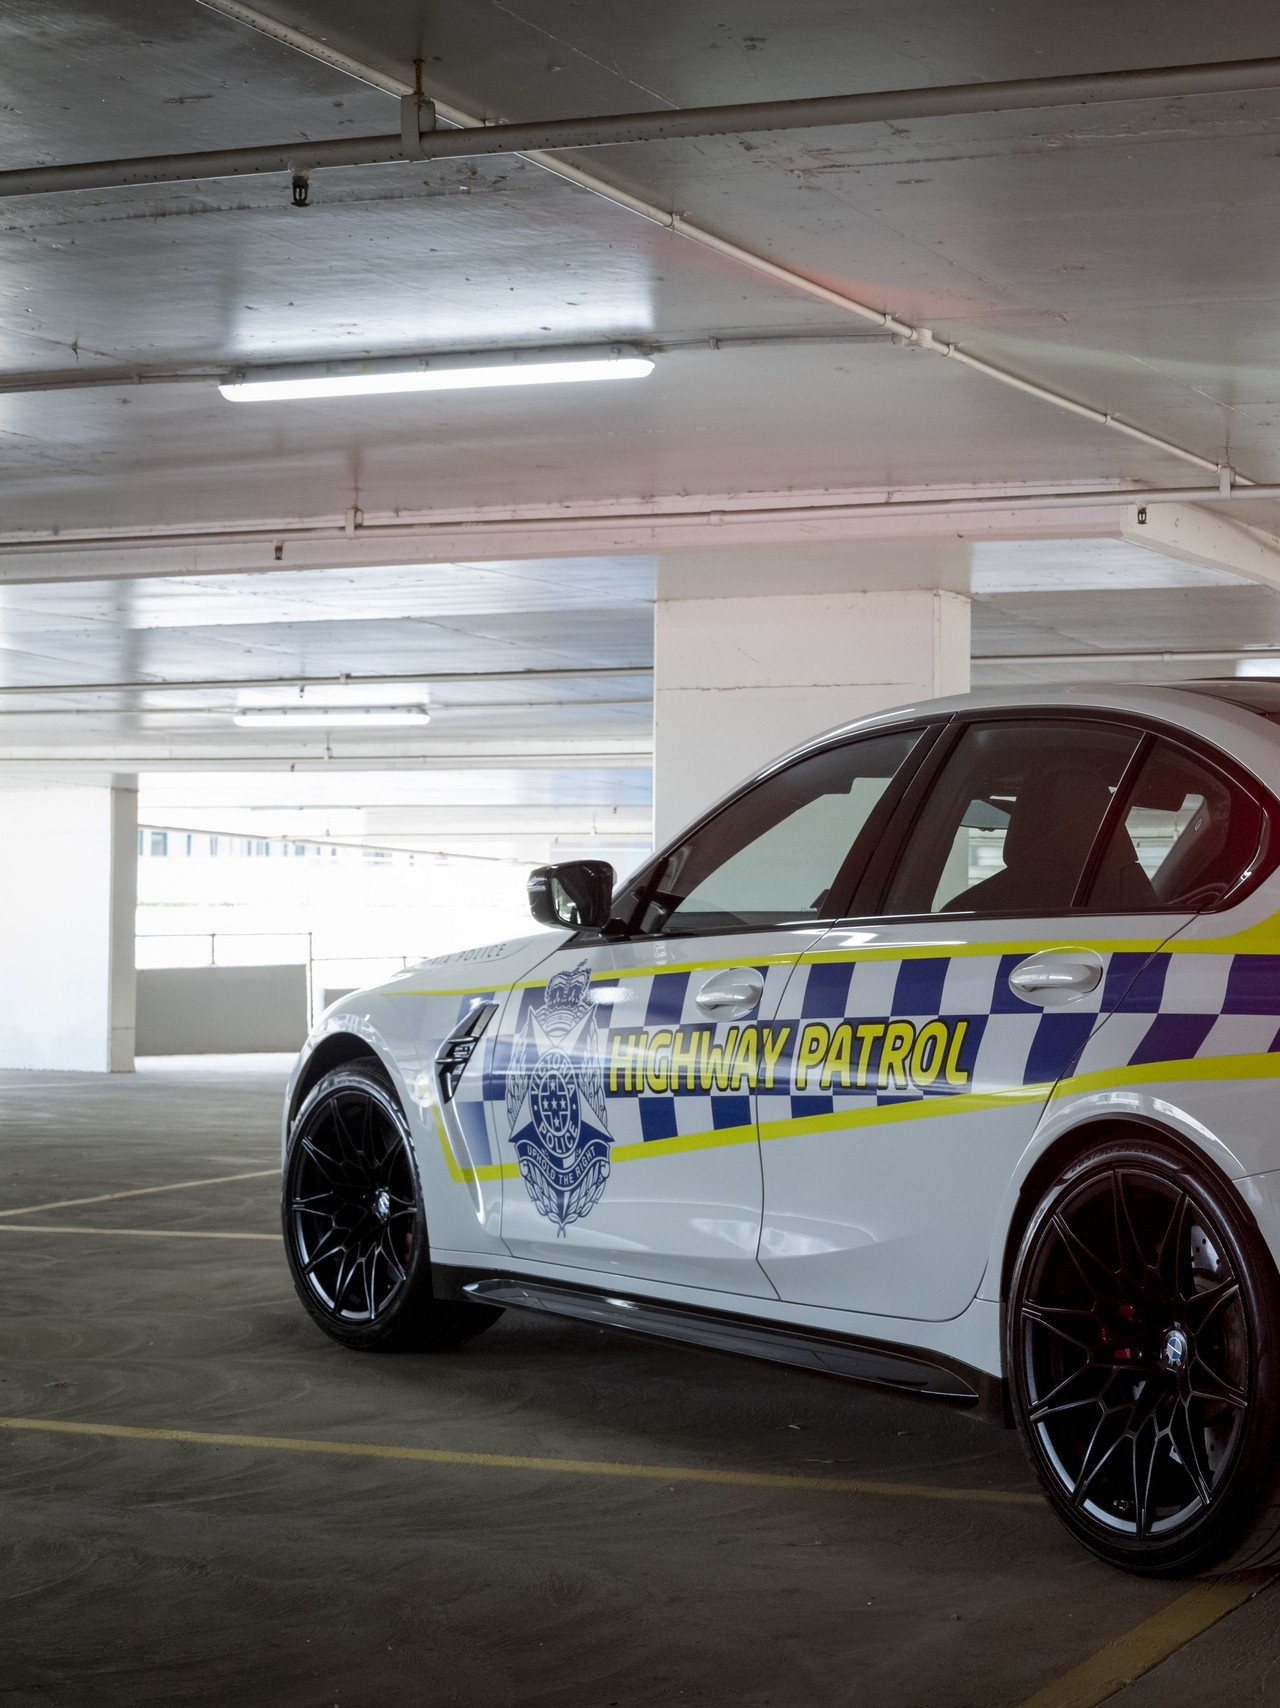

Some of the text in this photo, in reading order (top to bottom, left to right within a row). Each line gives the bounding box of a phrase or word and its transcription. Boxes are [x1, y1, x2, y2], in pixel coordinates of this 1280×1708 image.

[530, 1053, 576, 1098] VICTORIA
[608, 1018, 972, 1093] HIGHWAY PATROL
[538, 1120, 578, 1153] POLICE
[526, 1144, 597, 1186] UPHOLD THE RIGHT
